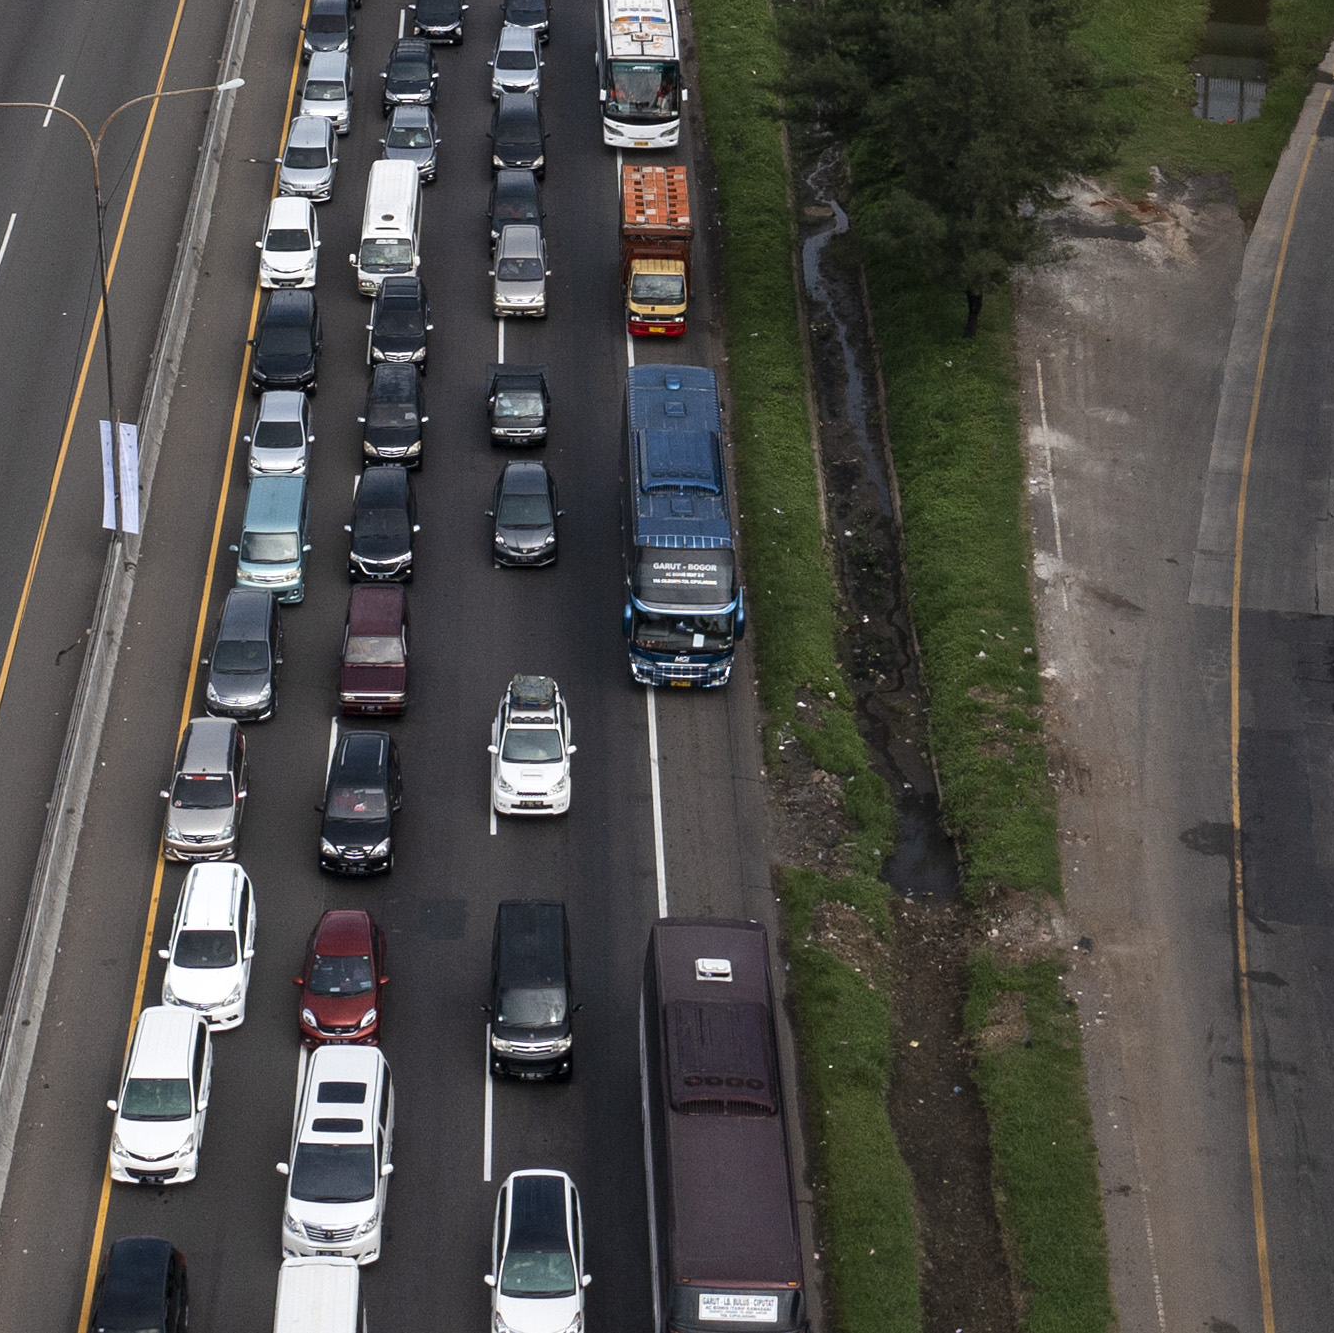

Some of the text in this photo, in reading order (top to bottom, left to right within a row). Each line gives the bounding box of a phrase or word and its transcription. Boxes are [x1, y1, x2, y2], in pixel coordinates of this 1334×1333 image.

[653, 562, 681, 570] GARUT
[688, 564, 717, 572] BOGOR
[702, 1297, 720, 1305] GARUT
[753, 1299, 774, 1307] CIPUTAT
